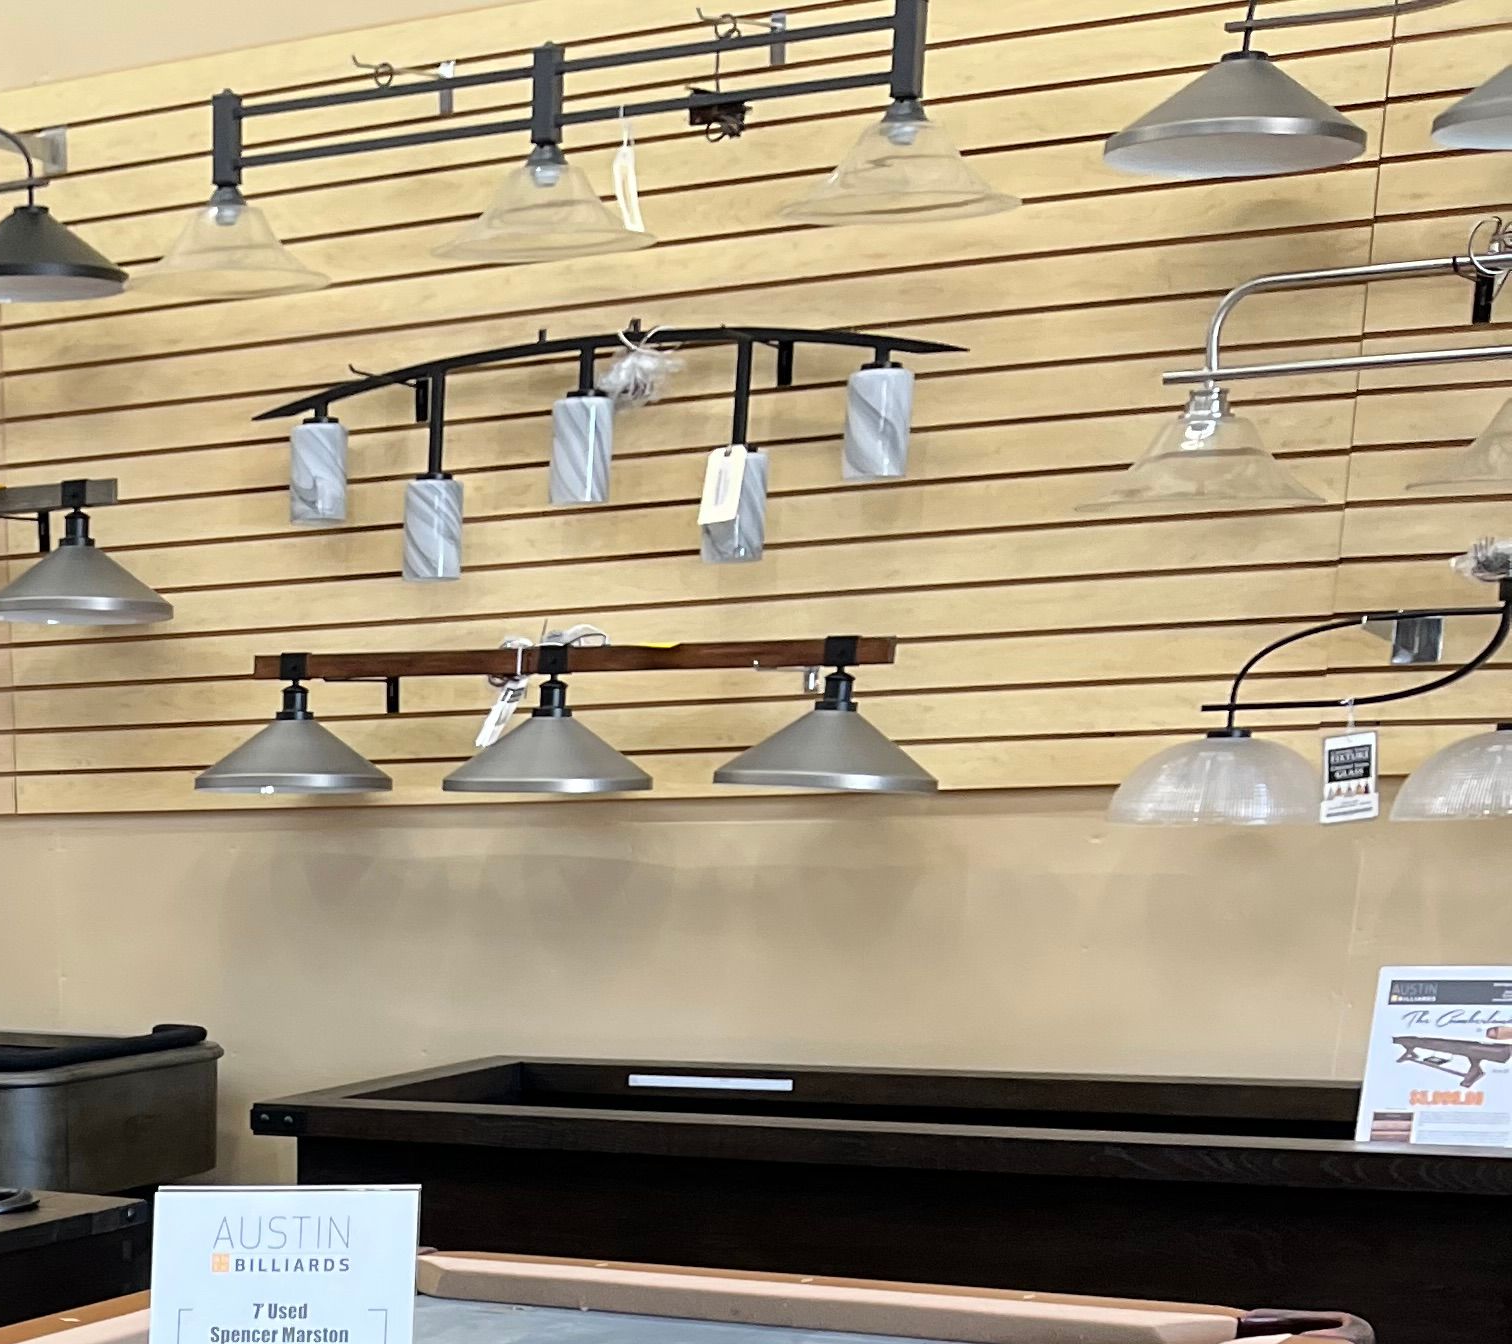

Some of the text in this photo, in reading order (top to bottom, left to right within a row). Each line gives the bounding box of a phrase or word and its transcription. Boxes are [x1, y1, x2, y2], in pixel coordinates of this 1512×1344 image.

[1392, 983, 1438, 996] AUSTIN
[1402, 1010, 1431, 1029] The
[212, 1215, 351, 1250] AUSTIN
[234, 1258, 350, 1273] BILLIARDS
[267, 1303, 308, 1320] Used
[210, 1326, 349, 1344] Spencer Marston
